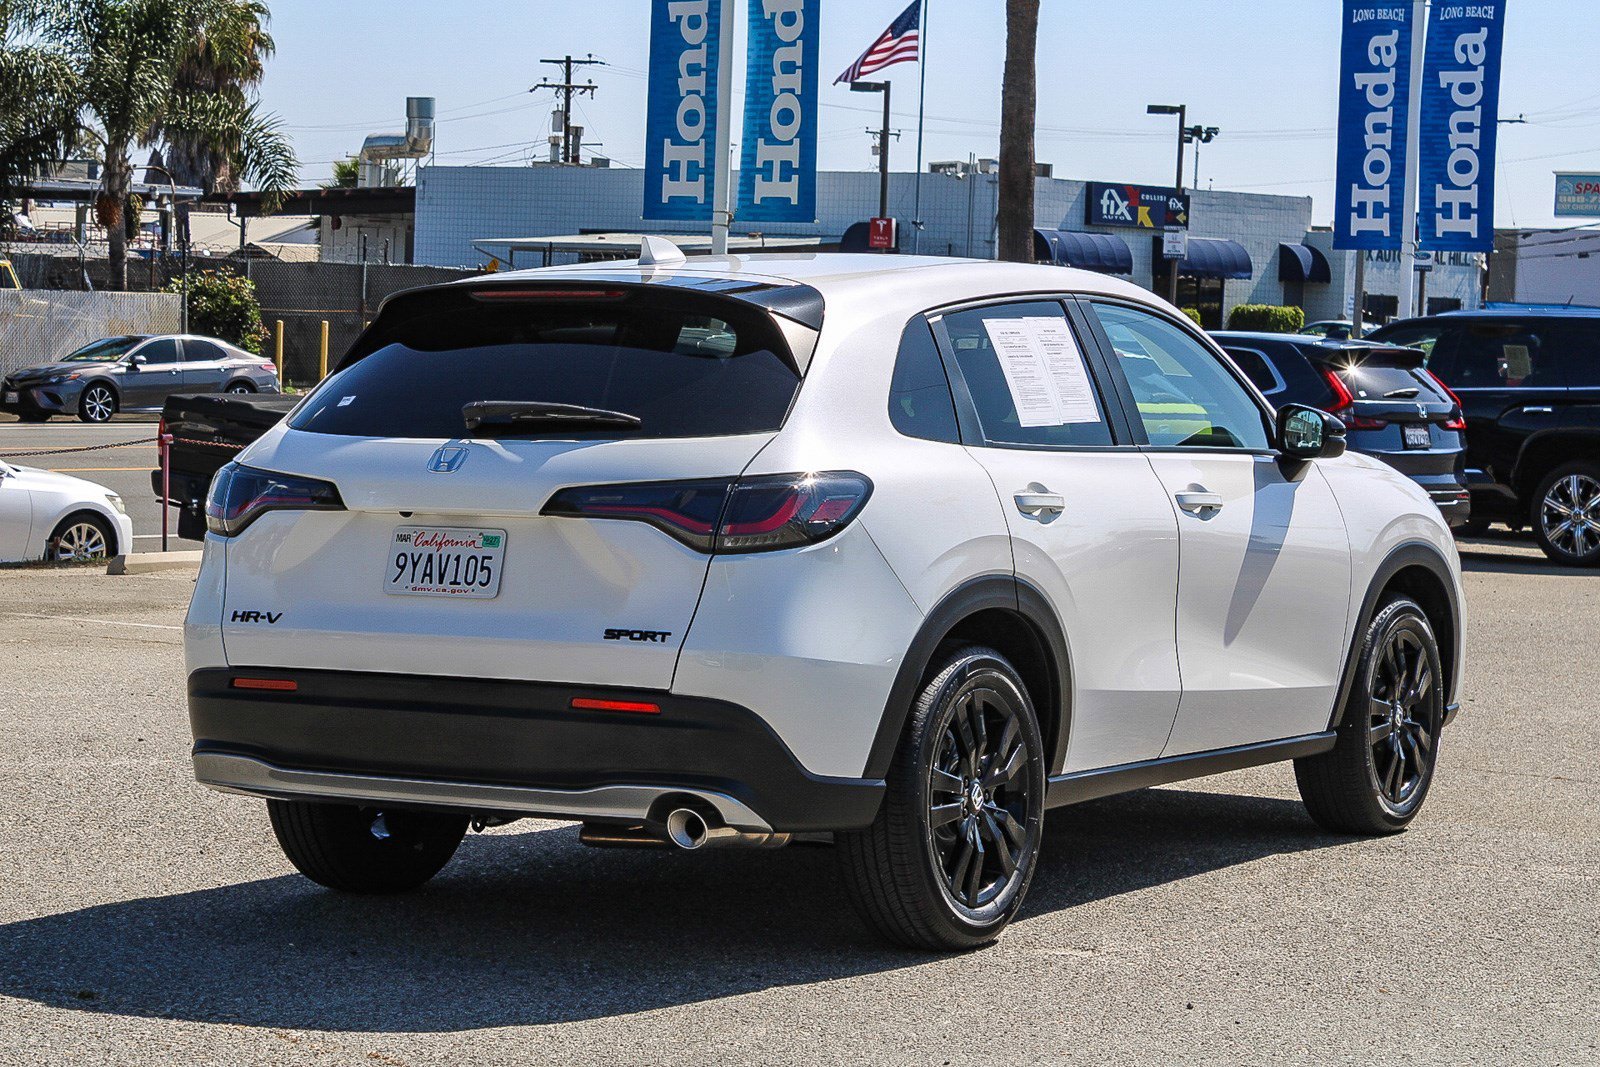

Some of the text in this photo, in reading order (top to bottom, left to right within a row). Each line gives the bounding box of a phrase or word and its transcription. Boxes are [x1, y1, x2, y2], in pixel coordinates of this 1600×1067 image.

[1352, 8, 1405, 23] LONG BEACH
[1440, 5, 1495, 21] LONG BEACH
[662, 0, 709, 204] Hond
[754, 0, 805, 205] Hond
[1350, 29, 1399, 237] Honda
[1435, 27, 1488, 238] Honda
[1574, 182, 1600, 195] SPA
[1141, 193, 1167, 202] COLLISI
[396, 533, 412, 543] MAR
[413, 531, 483, 553] California
[392, 552, 493, 588] 9YAV105
[411, 586, 470, 594] dmv.ca.gov
[231, 610, 283, 624] HR-V
[603, 629, 672, 643] SPORT
